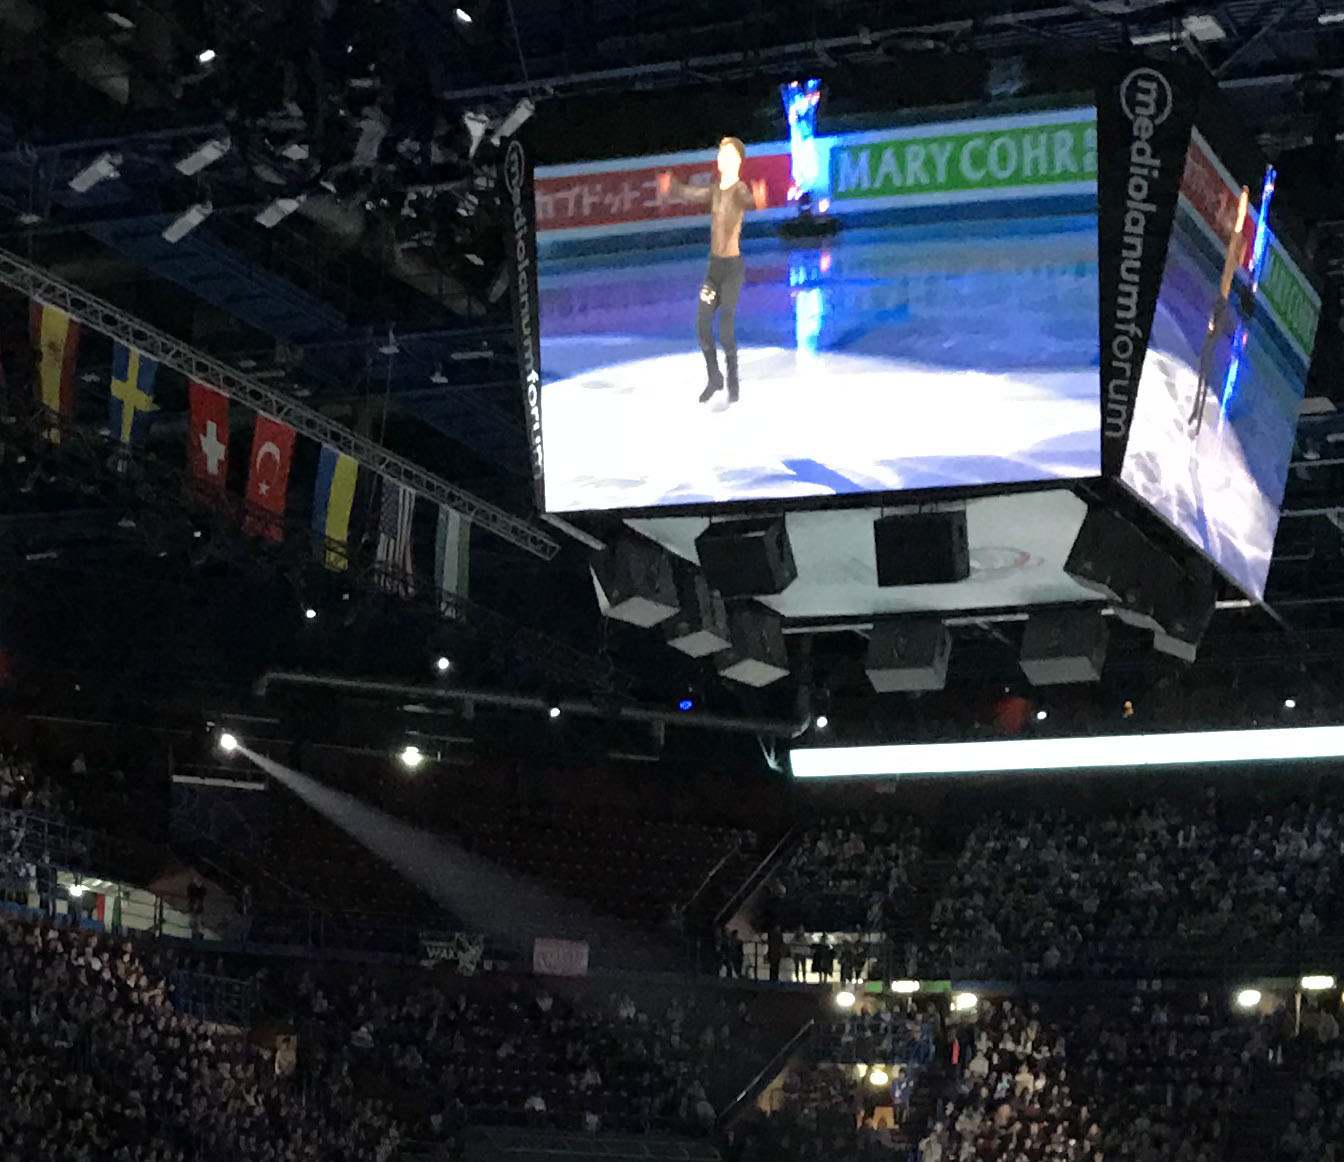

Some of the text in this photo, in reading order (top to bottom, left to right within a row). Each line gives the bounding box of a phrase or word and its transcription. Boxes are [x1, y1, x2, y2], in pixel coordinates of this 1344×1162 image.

[837, 143, 955, 193] MARY
[960, 128, 1079, 182] COHR
[1105, 76, 1160, 439] mediolanumforum
